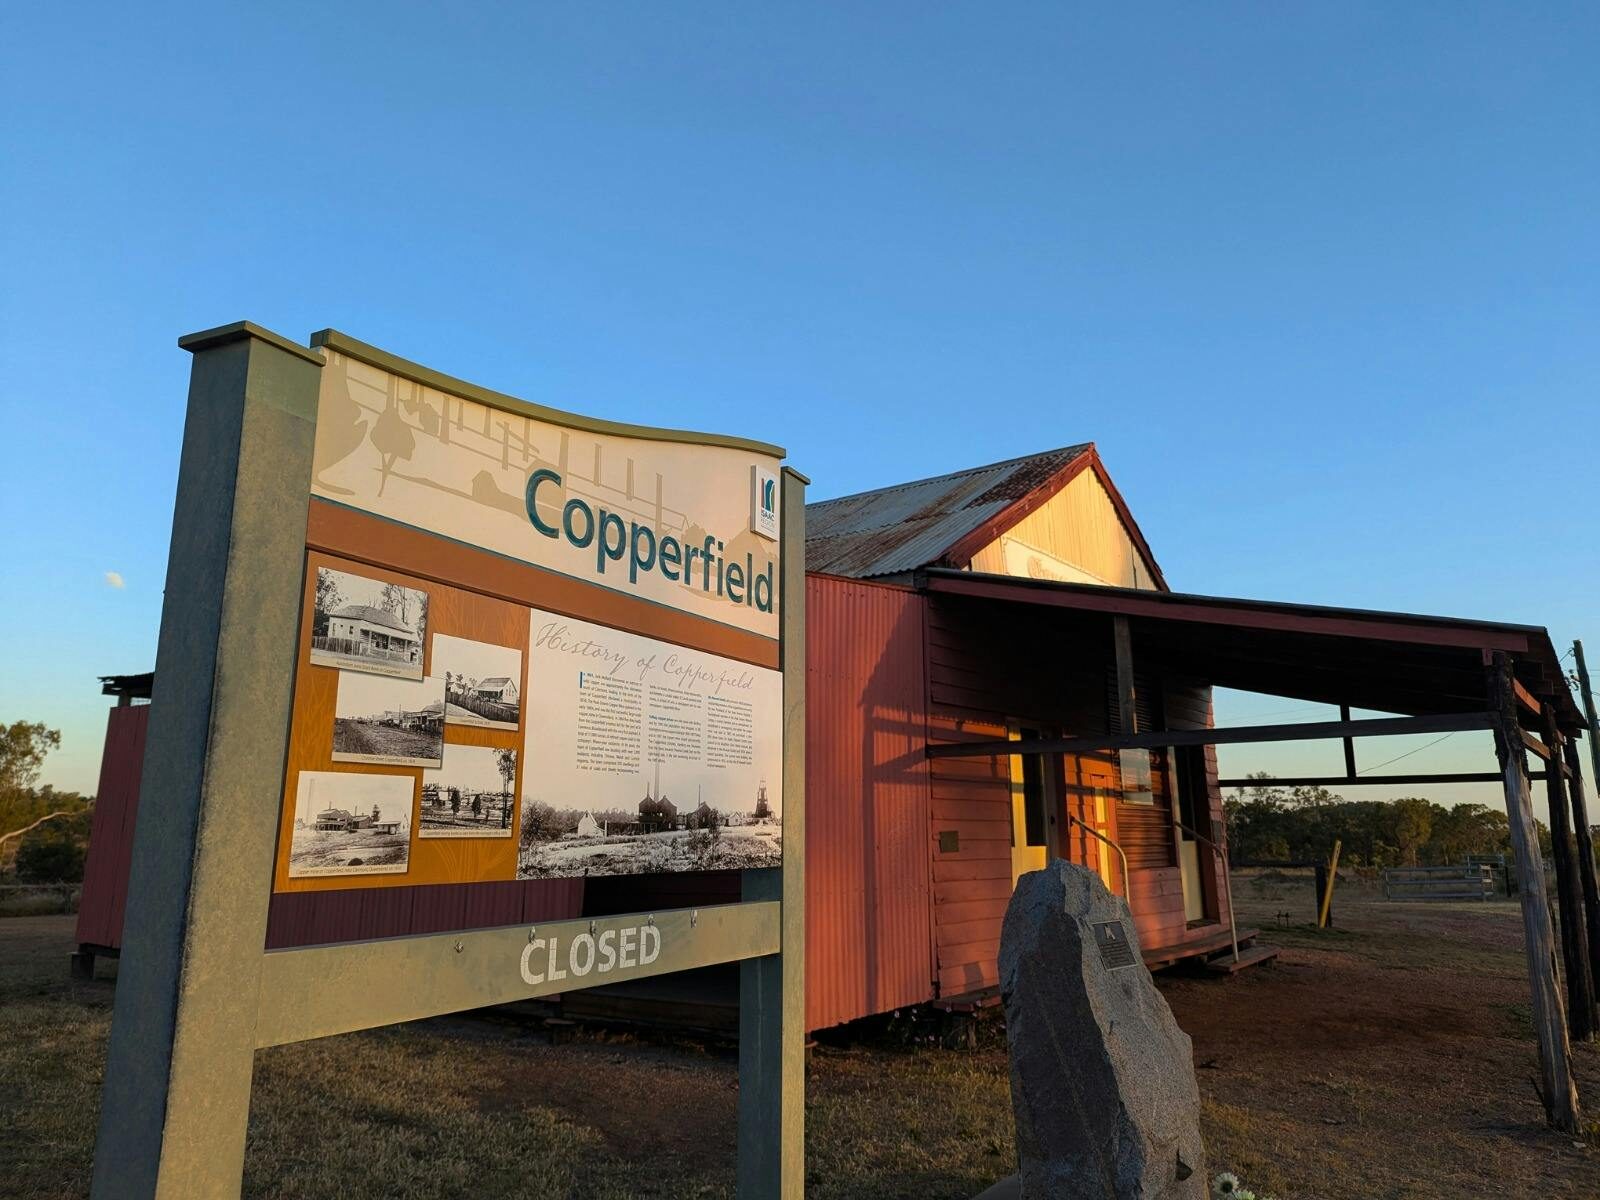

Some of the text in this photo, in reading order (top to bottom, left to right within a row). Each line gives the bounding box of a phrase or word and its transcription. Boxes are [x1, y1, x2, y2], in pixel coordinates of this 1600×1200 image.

[525, 468, 773, 614] Copperfield
[535, 622, 630, 674] History
[637, 654, 656, 679] of
[663, 654, 754, 694] Copperfield
[520, 925, 661, 985] CLOSED
